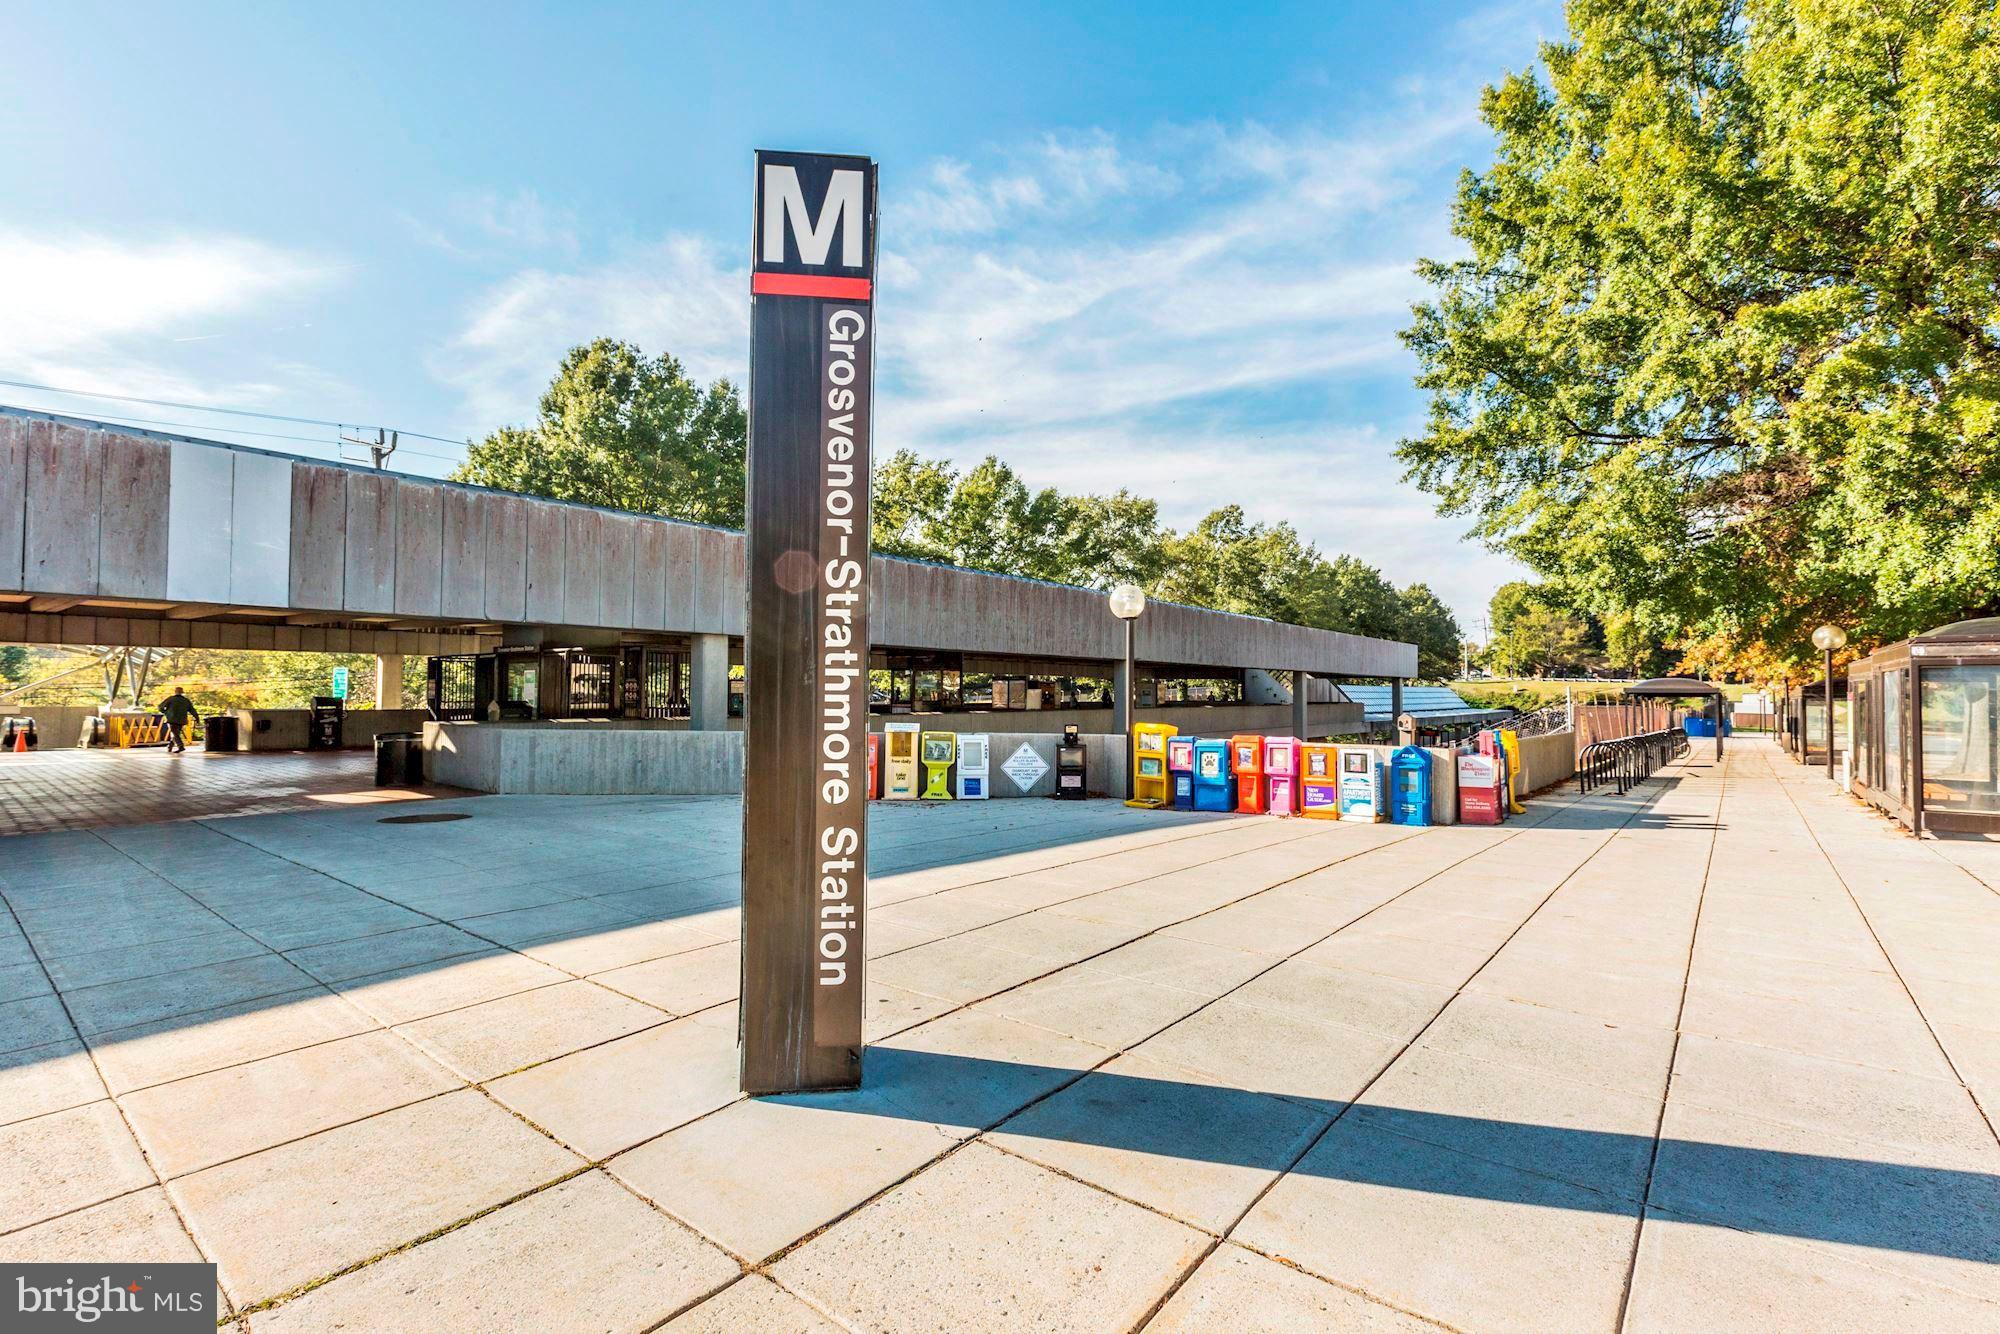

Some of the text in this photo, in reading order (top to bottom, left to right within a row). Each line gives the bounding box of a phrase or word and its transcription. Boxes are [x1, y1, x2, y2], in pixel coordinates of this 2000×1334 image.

[764, 165, 863, 267] M
[820, 309, 866, 986] Grosvenor-Strathmore Station
